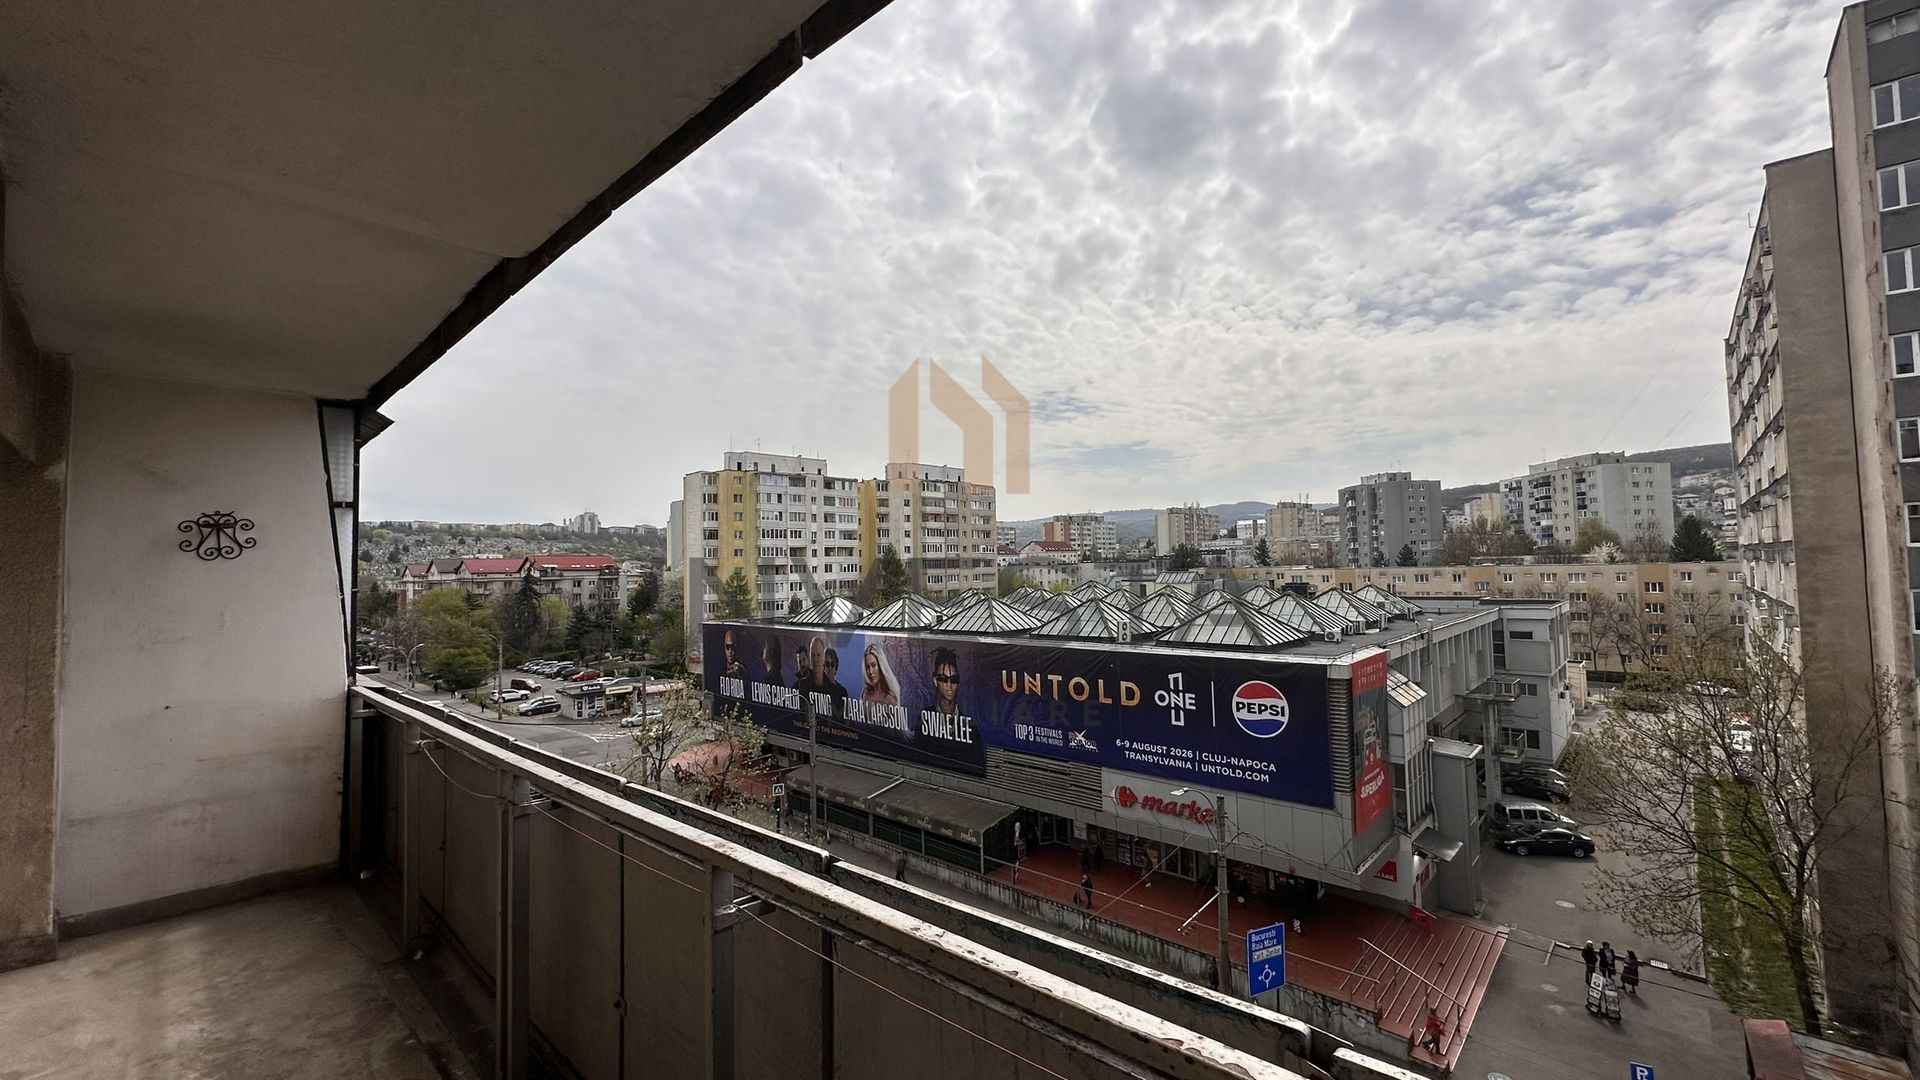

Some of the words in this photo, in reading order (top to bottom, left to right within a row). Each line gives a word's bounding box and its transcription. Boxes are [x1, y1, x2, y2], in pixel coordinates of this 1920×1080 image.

[719, 676, 731, 697] FLO
[731, 678, 745, 699] RIDA
[751, 681, 772, 705] LEWIS
[1001, 669, 1141, 707] UNTOLD
[808, 691, 833, 717] STING
[841, 696, 866, 724] ZARA
[867, 701, 909, 731] LARSSON
[1235, 701, 1286, 718] PEPSI
[921, 710, 953, 741] SWAE
[954, 714, 973, 744] LEE
[1014, 723, 1028, 740] TOP
[1028, 725, 1034, 741] 3
[1035, 726, 1063, 739] FESTIVALS
[1116, 738, 1130, 748] 6-9
[1132, 741, 1168, 754] AUGUST
[1170, 747, 1194, 759] 2026
[1202, 752, 1277, 773] CLUJ-NAPOCA
[1124, 751, 1193, 770] TRANSYLVANIA
[1201, 764, 1270, 783] UNTOLD.COM
[1141, 794, 1218, 826] marke
[1251, 942, 1262, 950] Baia
[1264, 939, 1277, 947] Mare
